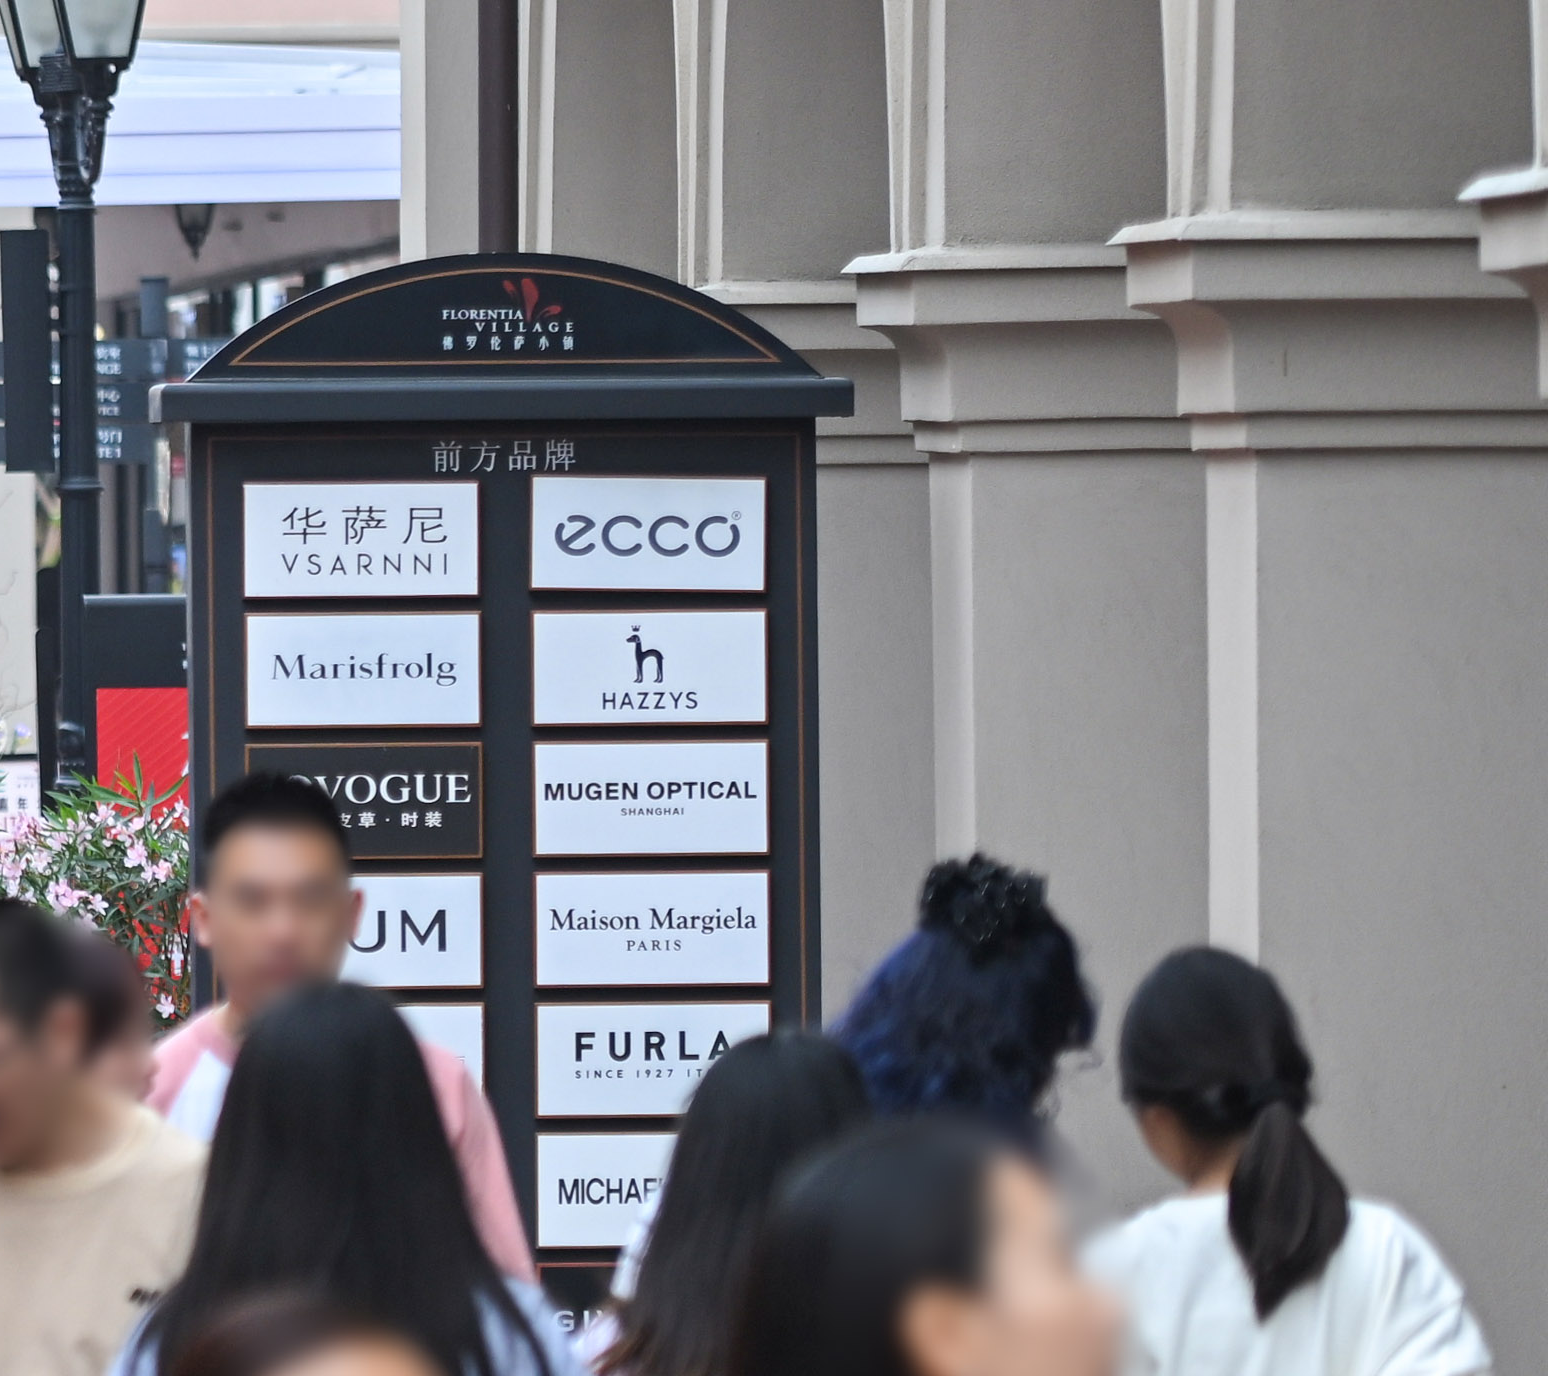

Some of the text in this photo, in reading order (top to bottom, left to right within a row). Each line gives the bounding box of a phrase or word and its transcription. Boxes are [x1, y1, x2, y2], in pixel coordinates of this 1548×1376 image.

[442, 309, 524, 320] FLORENTIA
[475, 322, 574, 333] VILLAGE
[432, 438, 576, 473] 前方品牌
[282, 506, 448, 545] 华萨尼
[281, 553, 448, 575] VSARNNI
[272, 652, 457, 687] Marisfrolg
[602, 691, 699, 710] HAZZYS
[544, 780, 758, 801] MUGEN OPTICAL
[620, 807, 685, 817] SHANGHAI
[549, 906, 758, 935] Maison Margiela
[626, 939, 683, 952] PARIS
[575, 1030, 732, 1062] FURLA
[575, 1069, 674, 1079] SINCE 1927
[558, 1177, 664, 1205] MICHAE
